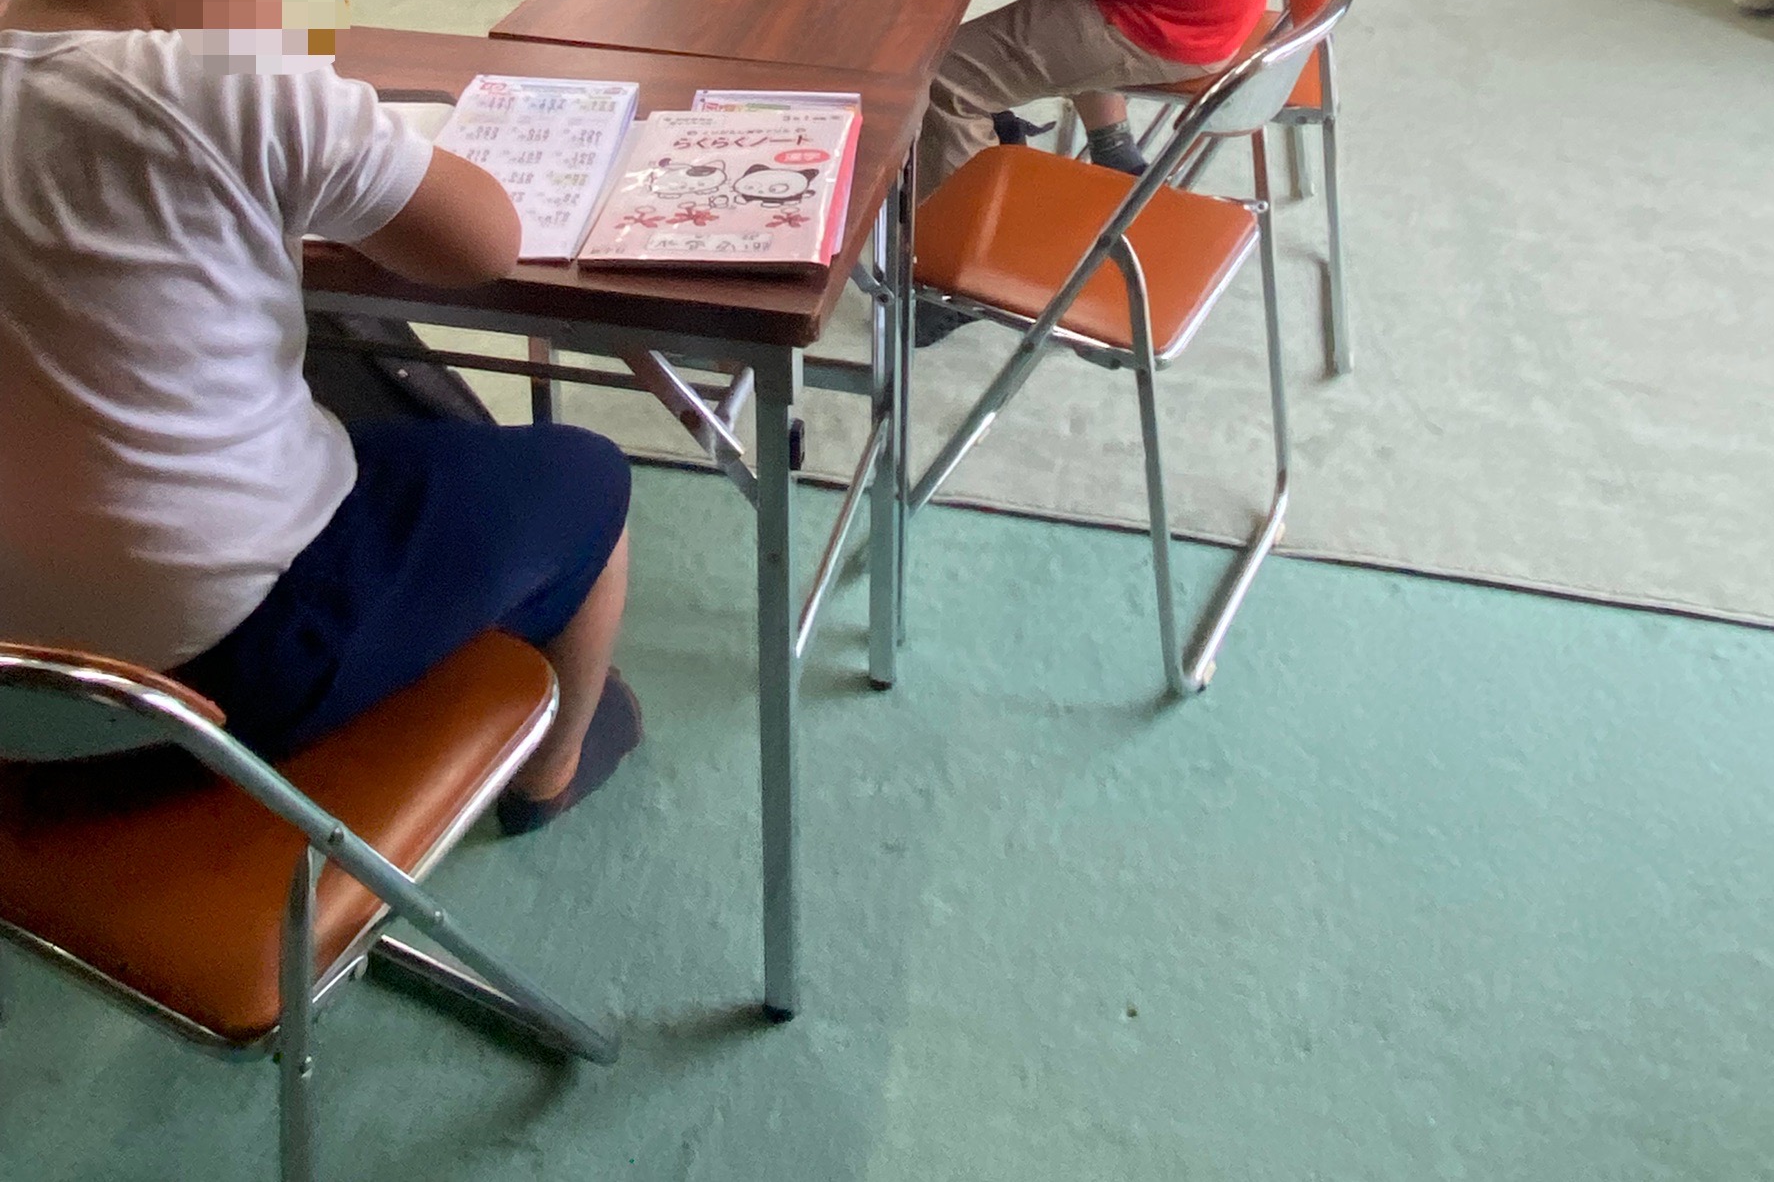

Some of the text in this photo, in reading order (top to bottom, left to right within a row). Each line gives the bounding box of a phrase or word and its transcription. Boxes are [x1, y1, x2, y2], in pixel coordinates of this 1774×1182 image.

[673, 135, 812, 149] らくらくノート
